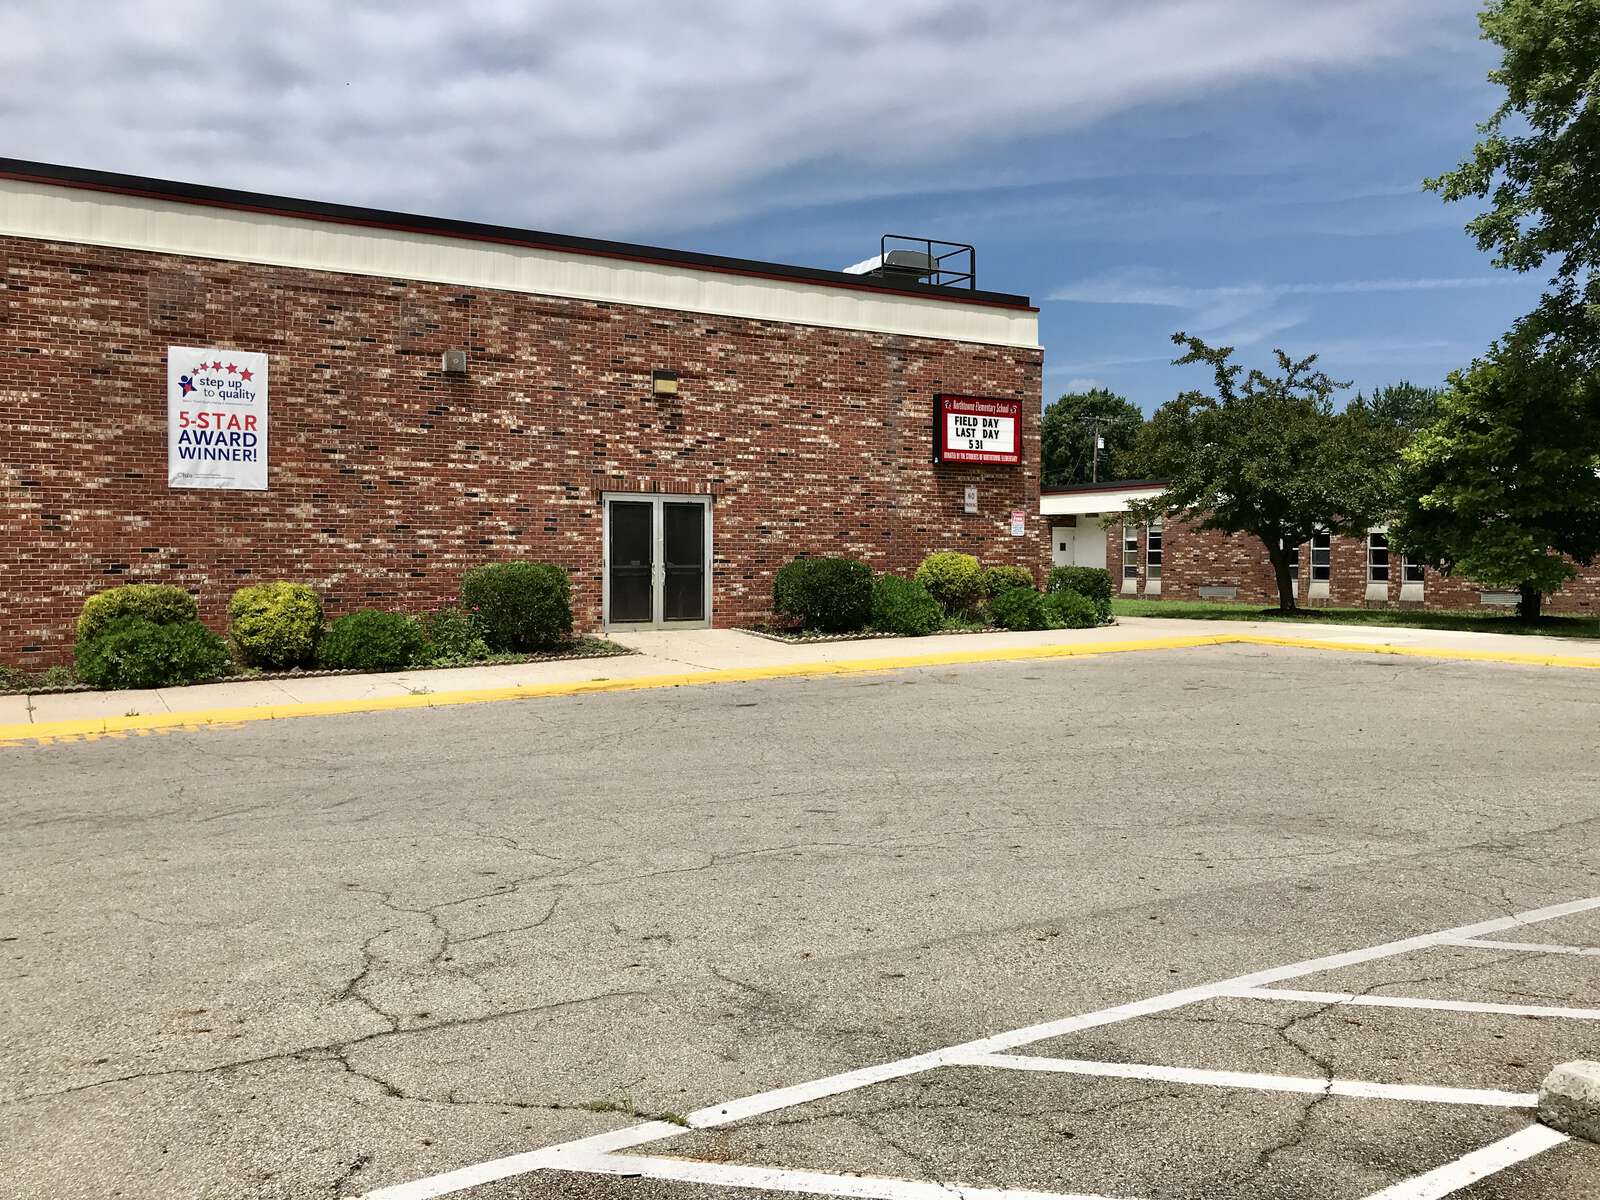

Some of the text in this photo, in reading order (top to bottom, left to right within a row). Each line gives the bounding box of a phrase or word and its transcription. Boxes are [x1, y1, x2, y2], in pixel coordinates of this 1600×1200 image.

[200, 378, 242, 391] step up
[204, 388, 256, 402] to quality
[975, 401, 996, 414] Elementary
[996, 403, 1009, 413] School
[179, 411, 257, 431] 5-STAR
[954, 416, 999, 428] FIELD DAY
[178, 429, 258, 448] AWARD
[956, 427, 1000, 439] LAST DAY
[178, 446, 257, 462] WINNER!
